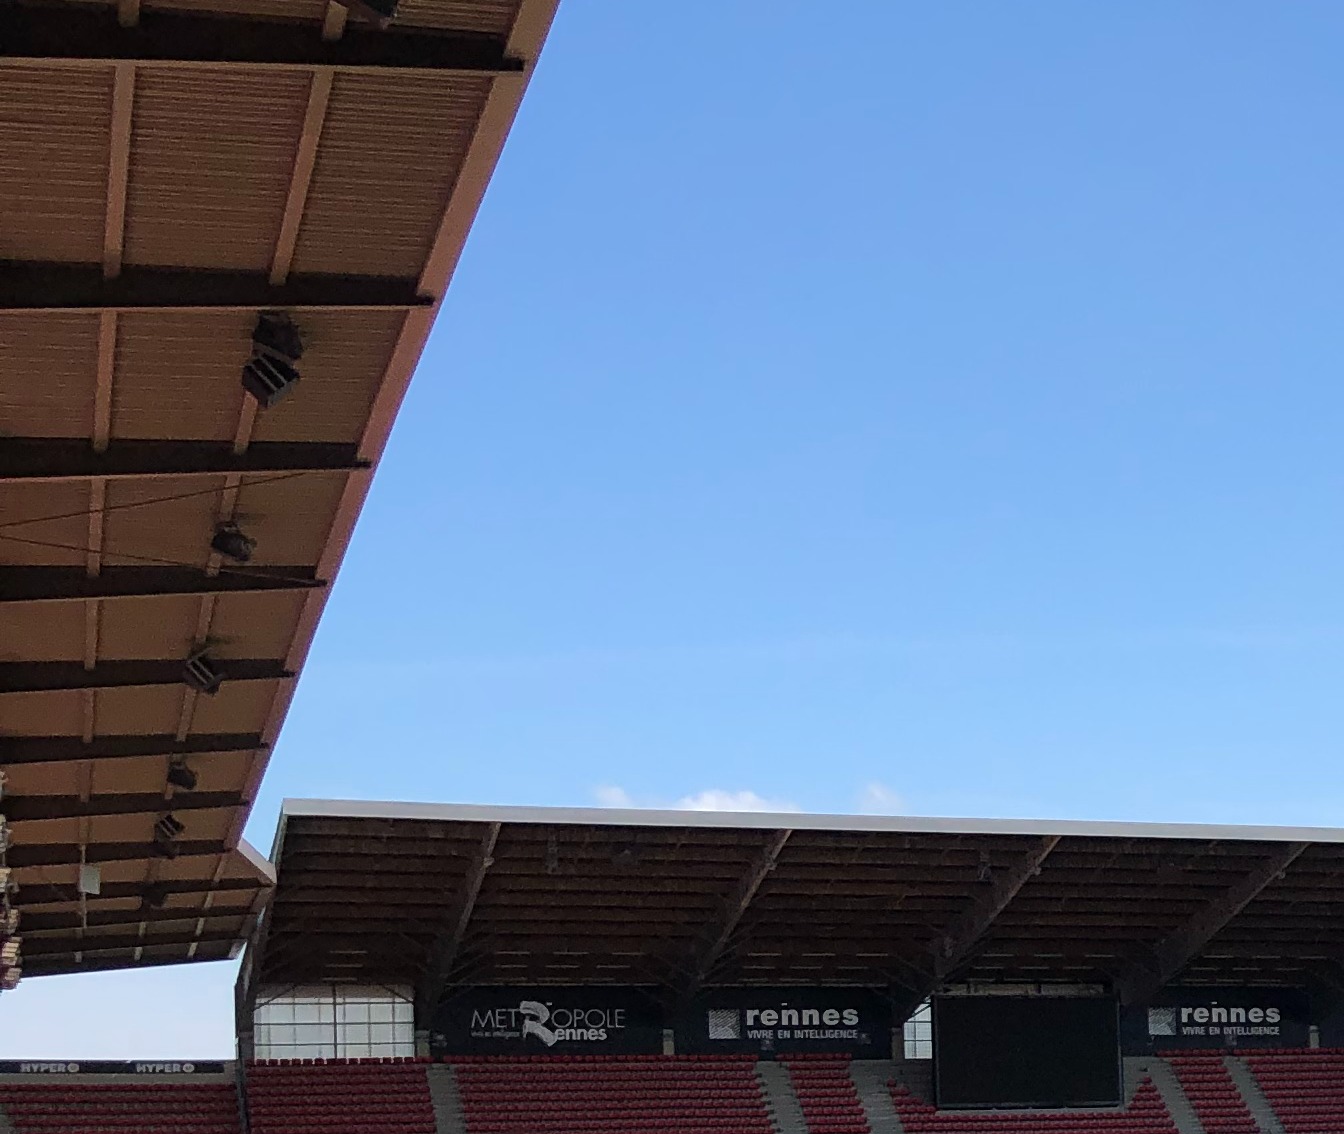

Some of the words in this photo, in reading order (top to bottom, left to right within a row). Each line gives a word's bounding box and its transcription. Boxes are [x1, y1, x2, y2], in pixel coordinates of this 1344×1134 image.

[746, 1007, 859, 1026] rennes
[1181, 1006, 1281, 1023] rennes
[747, 1029, 774, 1039] VIVRE
[778, 1029, 791, 1039] EN
[794, 1029, 858, 1039] INTELLIGENCE
[1182, 1026, 1206, 1035] VIVRE
[1209, 1026, 1221, 1035] EN
